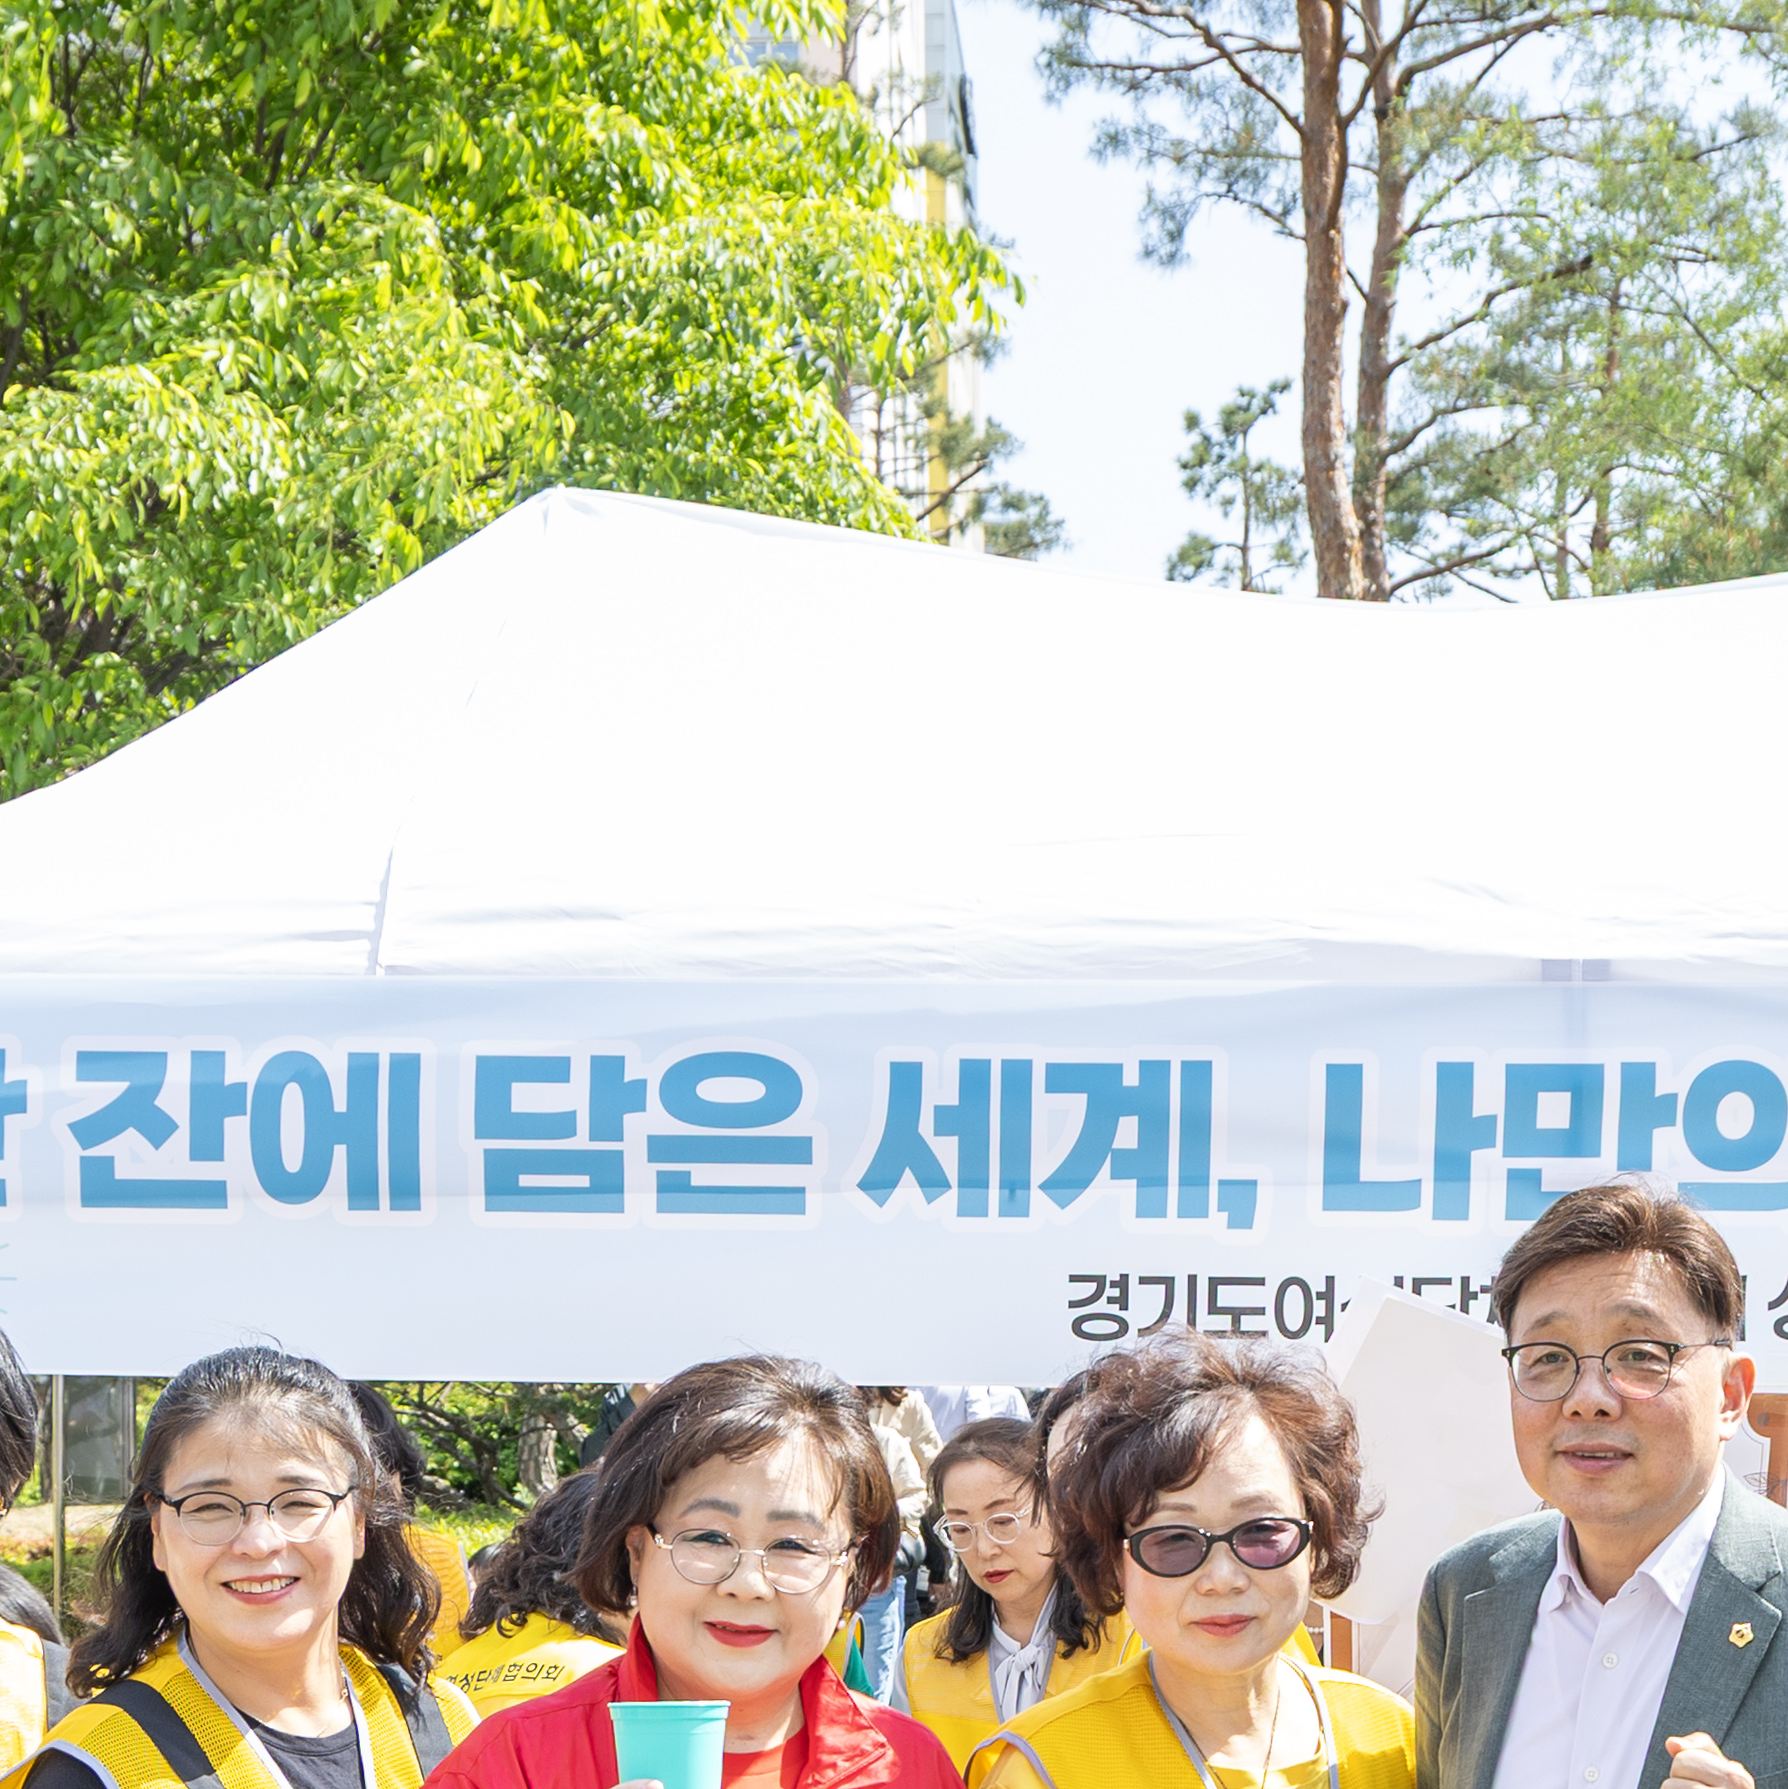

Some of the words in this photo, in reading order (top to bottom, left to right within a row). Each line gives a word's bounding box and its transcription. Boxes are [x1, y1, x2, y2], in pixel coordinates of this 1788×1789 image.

[68, 1048, 423, 1213] 잔에
[474, 1050, 814, 1216] 담은
[856, 1058, 1258, 1230] 세계,
